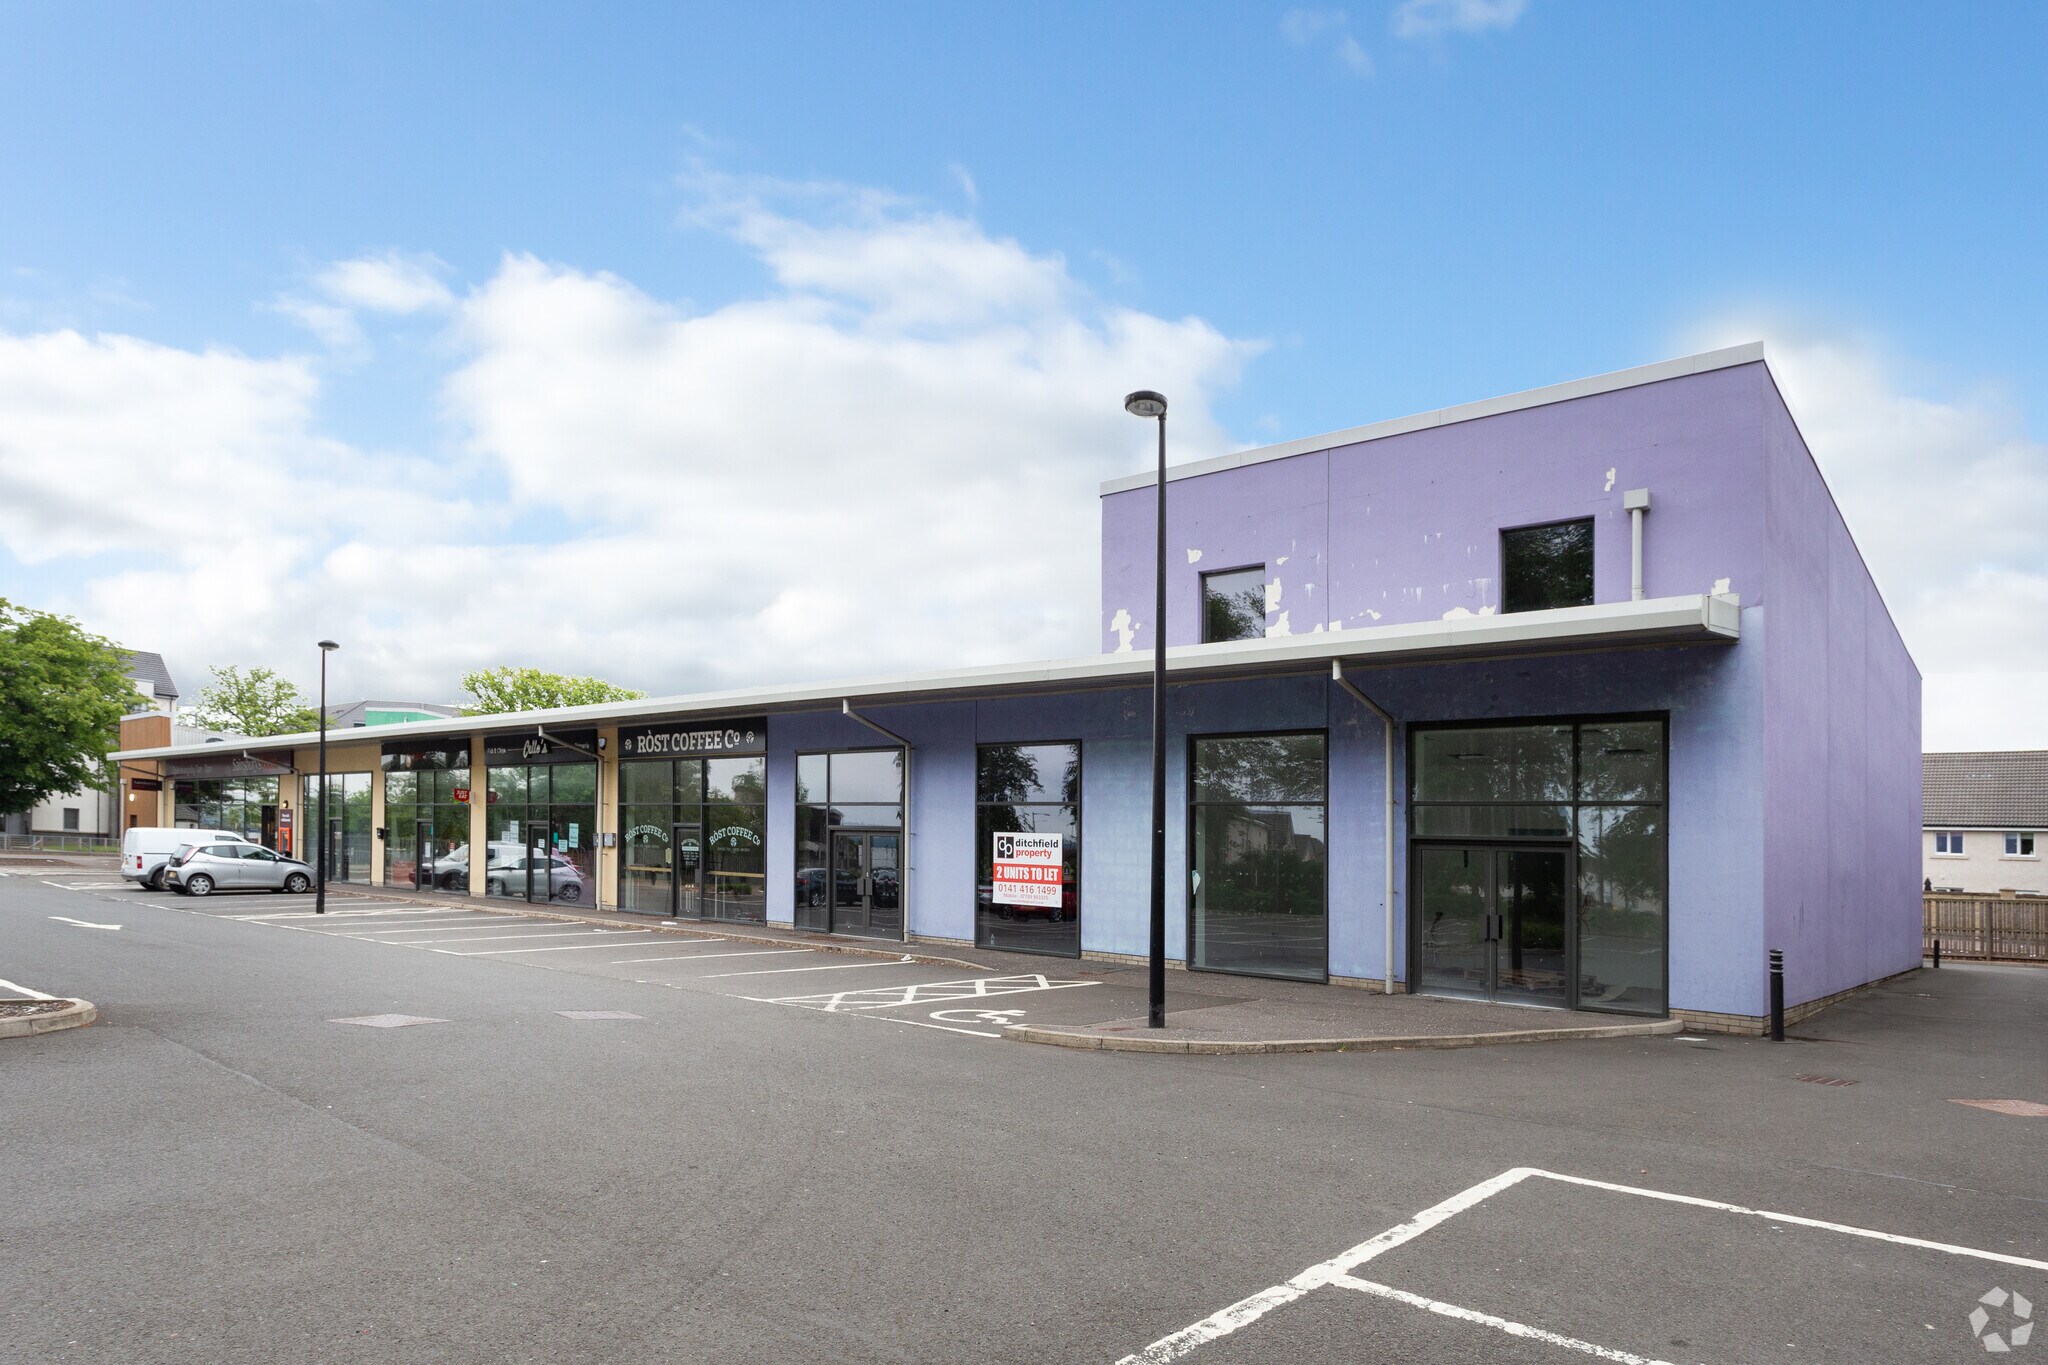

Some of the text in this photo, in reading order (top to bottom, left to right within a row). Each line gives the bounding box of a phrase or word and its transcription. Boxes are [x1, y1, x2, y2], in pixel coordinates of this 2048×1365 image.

[671, 730, 722, 751] COFFEE
[640, 824, 663, 838] COFFEE
[726, 826, 754, 841] COFFEE
[1015, 838, 1058, 848] ditchfield
[1015, 849, 1052, 859] property
[996, 866, 1059, 881] 2 UNITS TO LET
[998, 883, 1057, 896] 0141 416 1499
